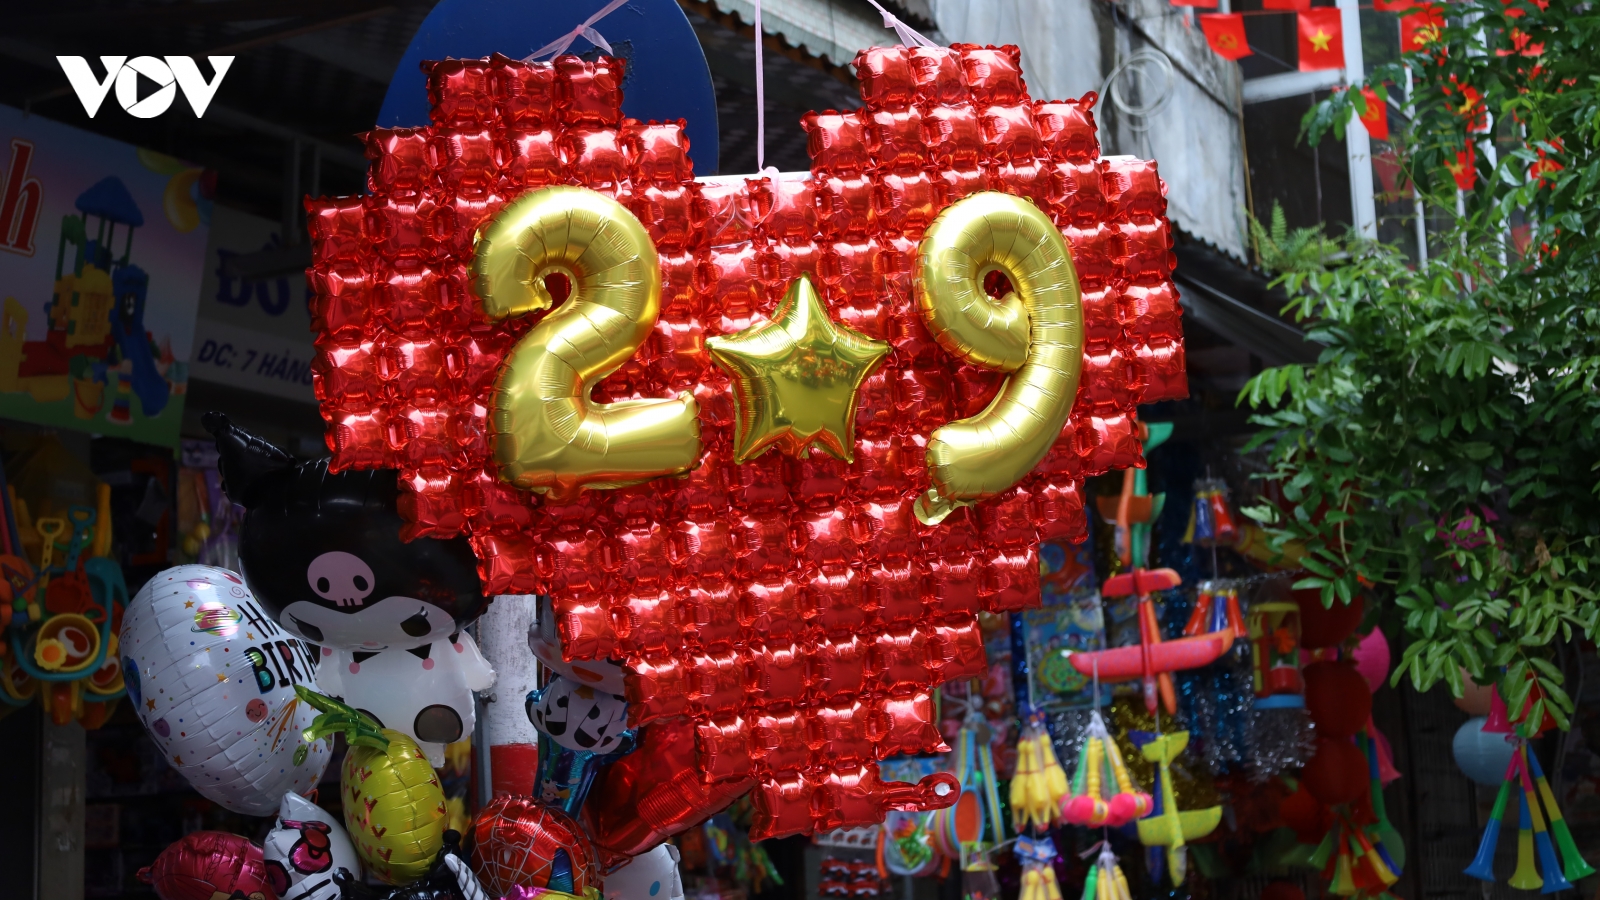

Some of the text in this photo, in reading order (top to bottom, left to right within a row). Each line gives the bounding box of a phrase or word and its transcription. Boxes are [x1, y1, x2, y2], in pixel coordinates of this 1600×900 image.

[0, 139, 42, 255] h
[241, 349, 257, 371] 7
[469, 186, 1084, 524] 2 9
